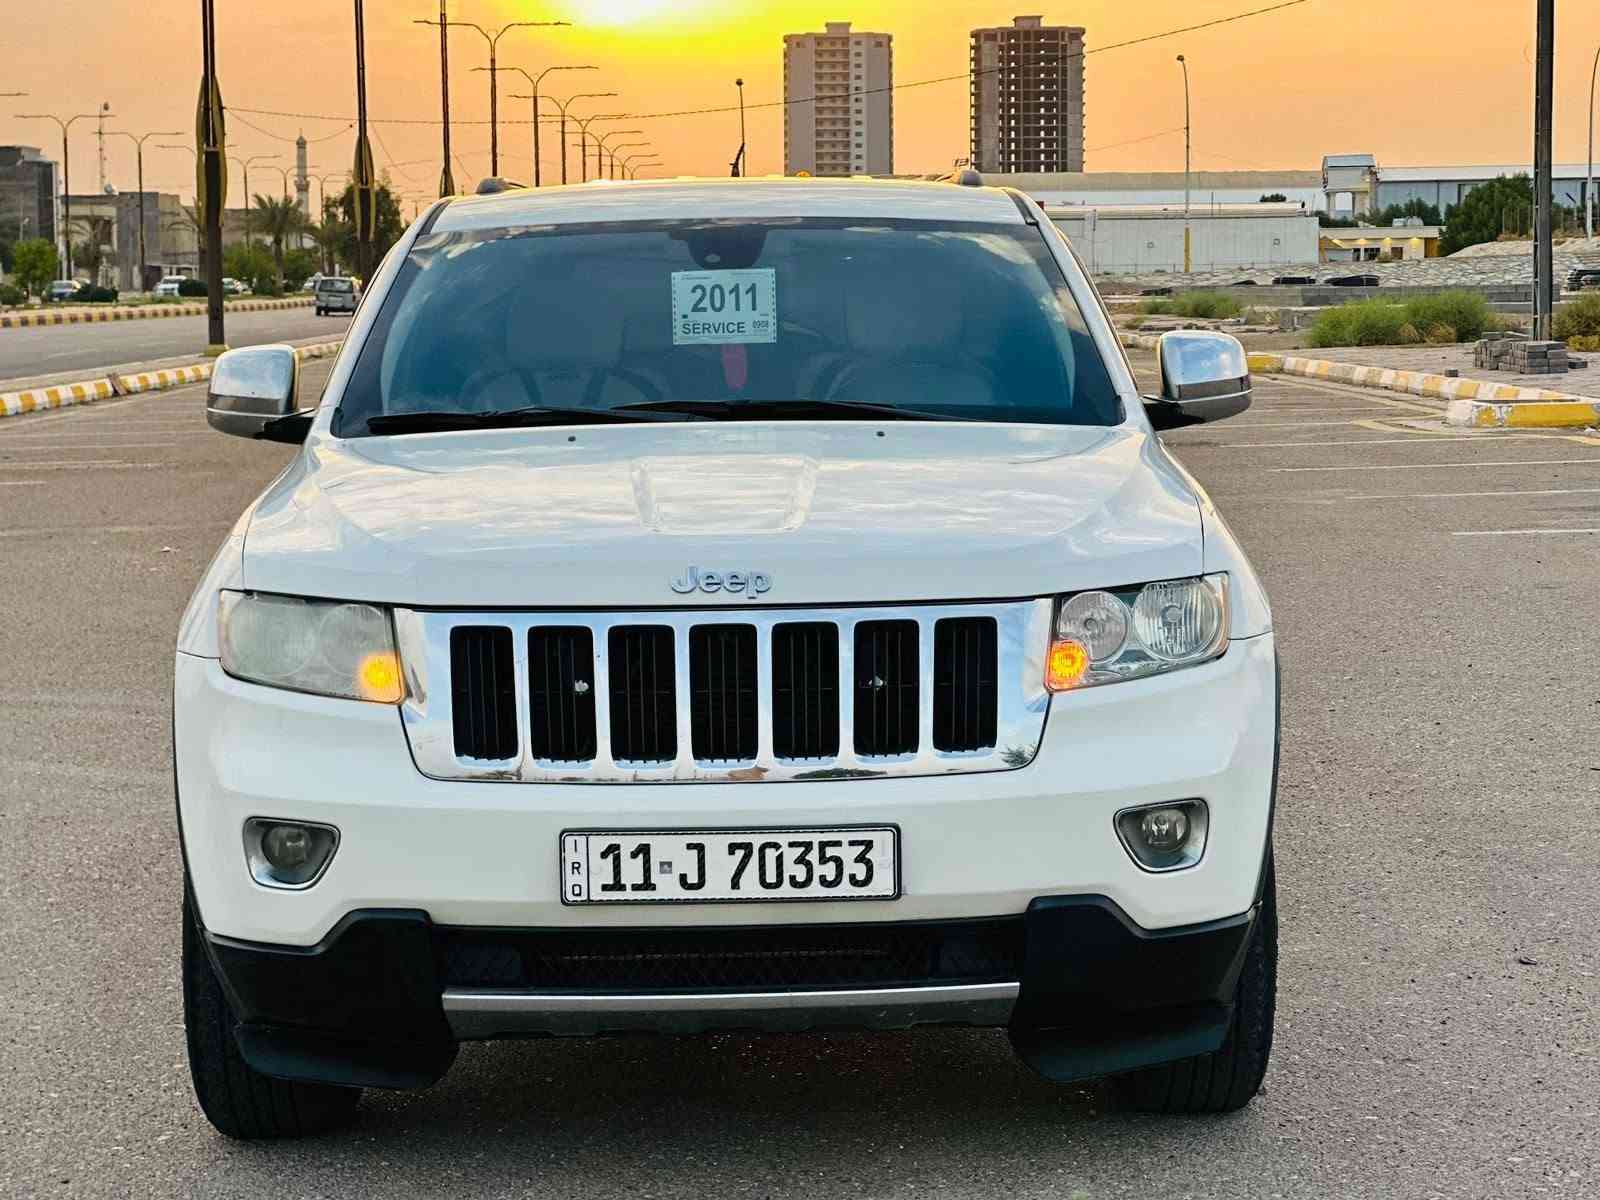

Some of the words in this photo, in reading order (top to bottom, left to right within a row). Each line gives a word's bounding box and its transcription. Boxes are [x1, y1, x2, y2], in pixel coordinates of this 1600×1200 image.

[691, 283, 757, 312] 2011
[682, 322, 746, 334] SERVICE
[671, 566, 772, 599] Jeep
[728, 839, 874, 890] 70353
